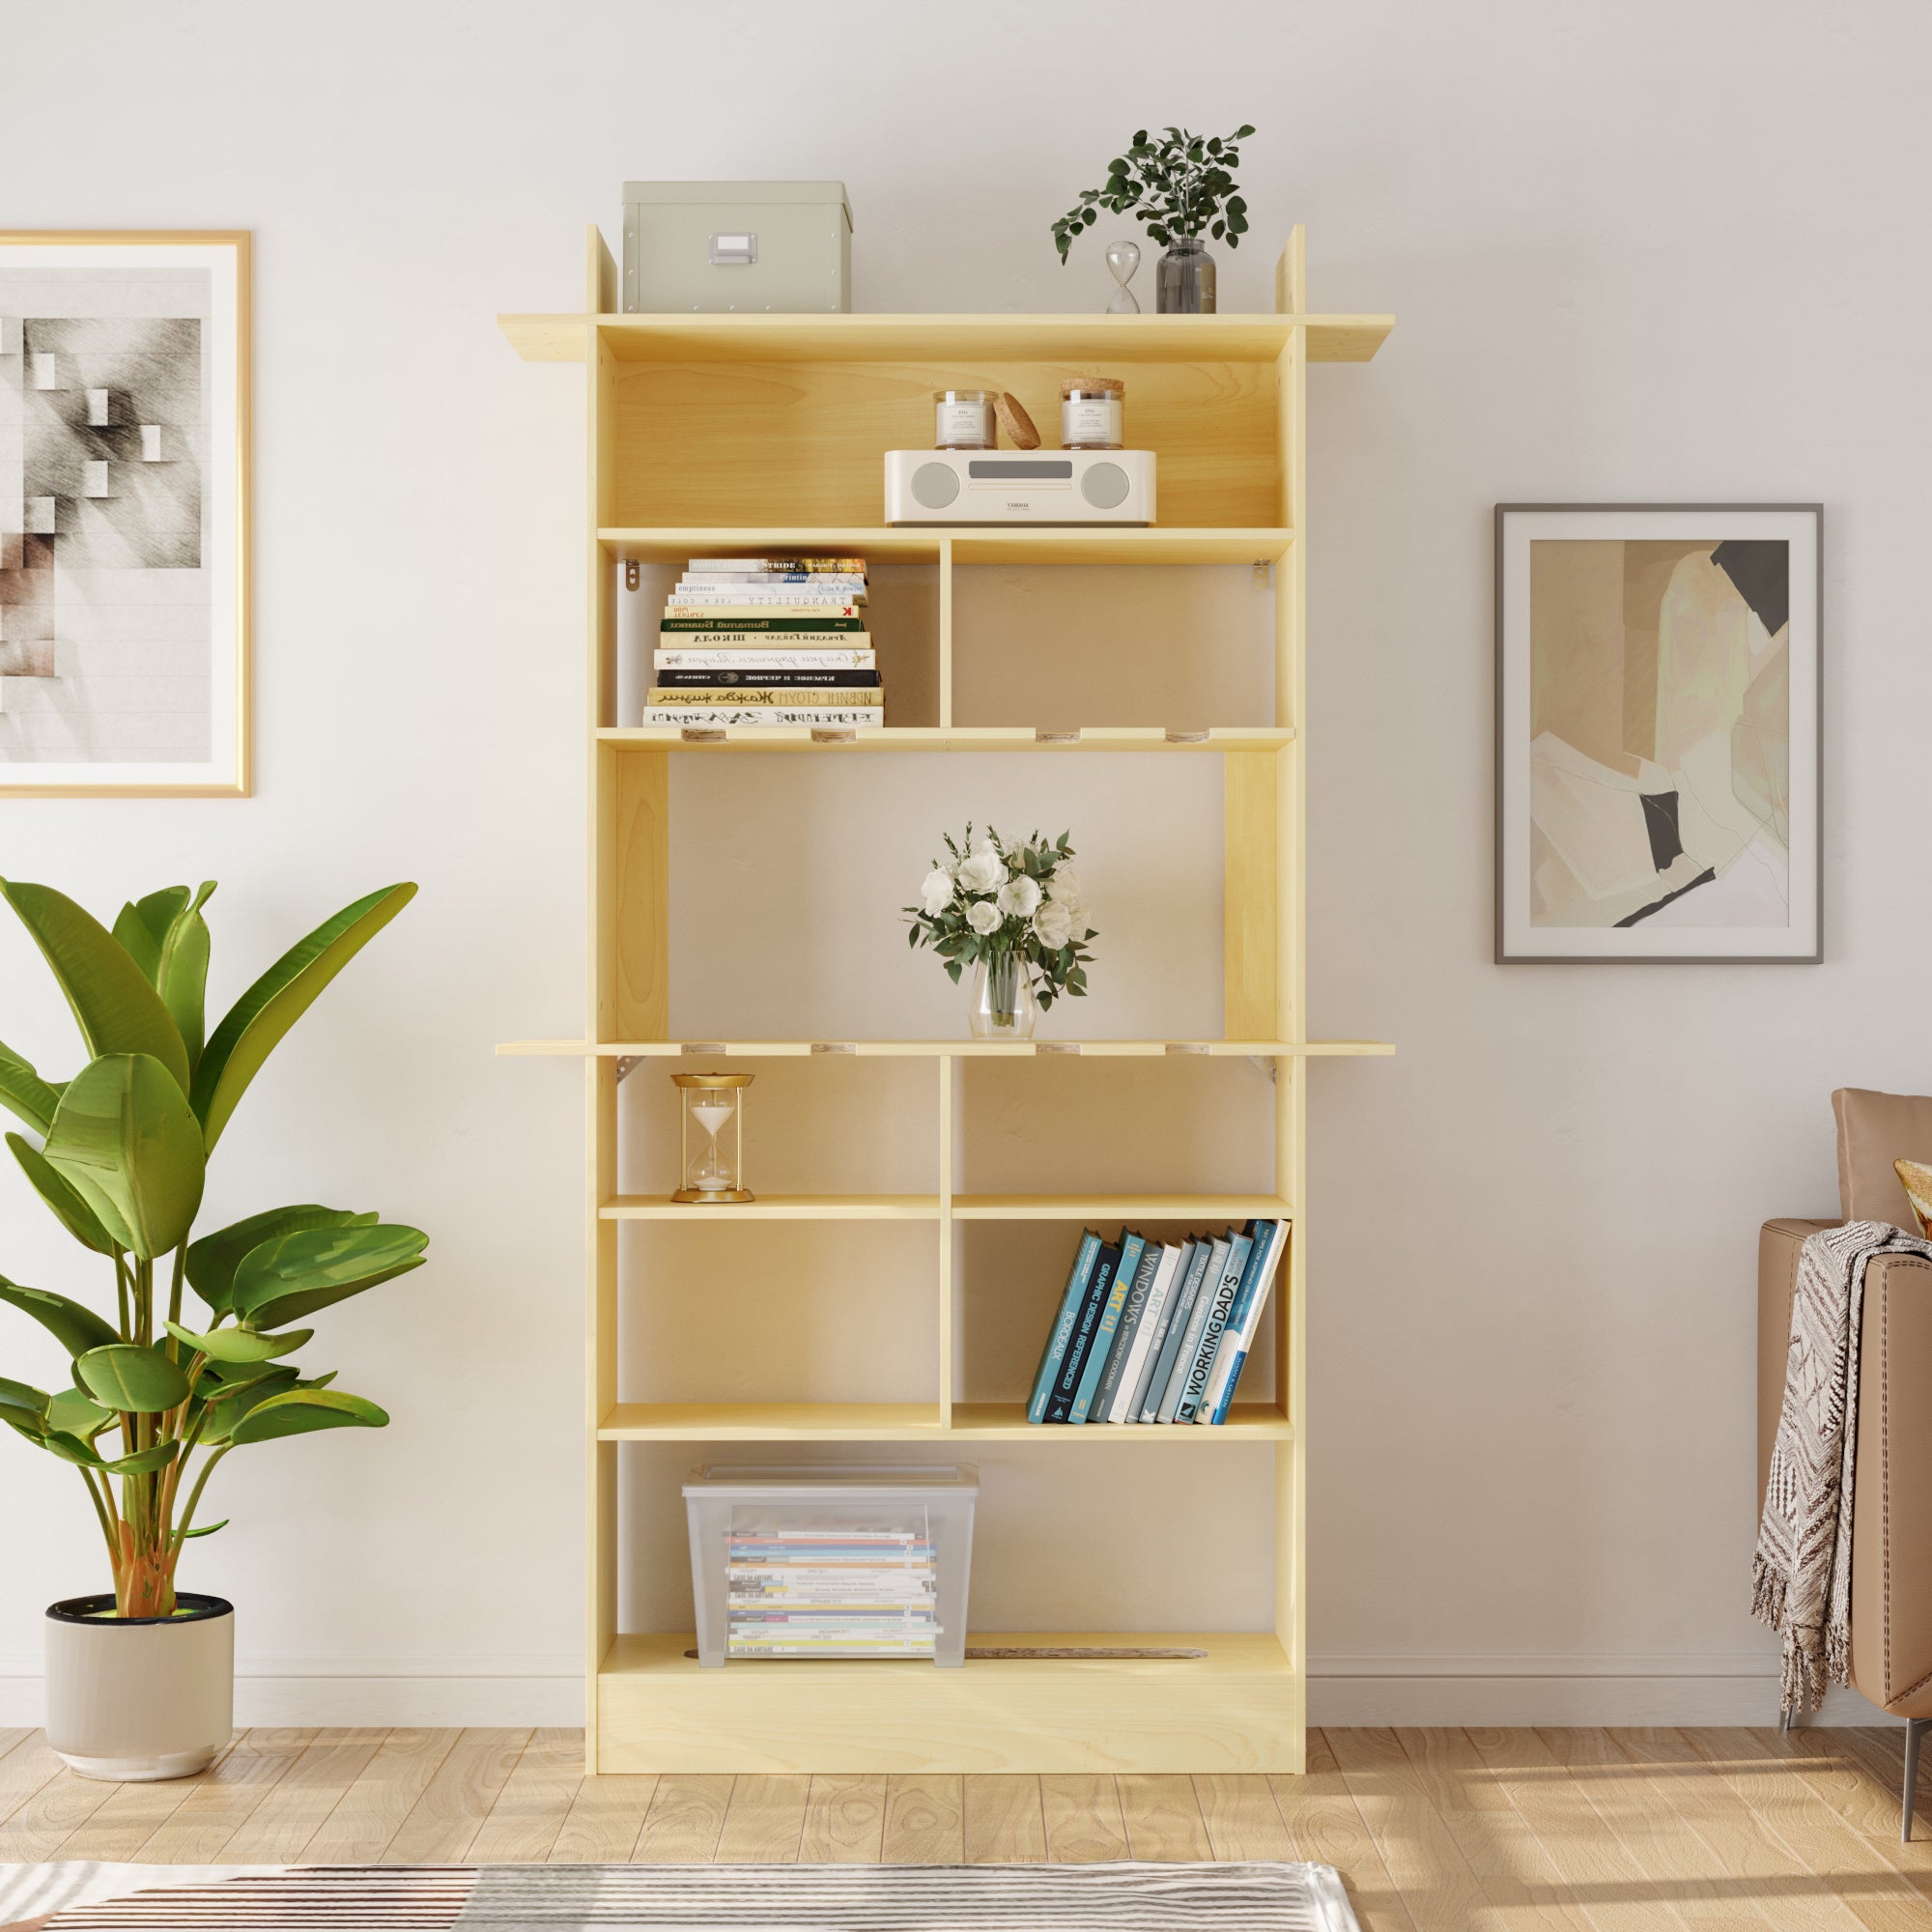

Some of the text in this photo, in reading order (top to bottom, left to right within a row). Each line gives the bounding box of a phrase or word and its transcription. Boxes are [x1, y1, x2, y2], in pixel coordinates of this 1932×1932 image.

[678, 584, 716, 593] emptiness
[1090, 1262, 1111, 1302] GRAPHIC
[1106, 1278, 1129, 1312] ART
[1122, 1247, 1159, 1325] WINDOWS
[1182, 1253, 1208, 1310] TEXTILE DESIGNERS
[1079, 1301, 1098, 1334] DESIGN
[1146, 1287, 1165, 1318] ART
[1050, 1310, 1076, 1360] BORDEAUX
[1112, 1329, 1129, 1360] BERGDORF
[1175, 1294, 1210, 1375] Gardens in France
[1185, 1320, 1223, 1397] WORKING
[1210, 1273, 1239, 1321] DAD'S
[1061, 1333, 1088, 1389] REFERENCED
[1102, 1359, 1120, 1391] GOODMAN
